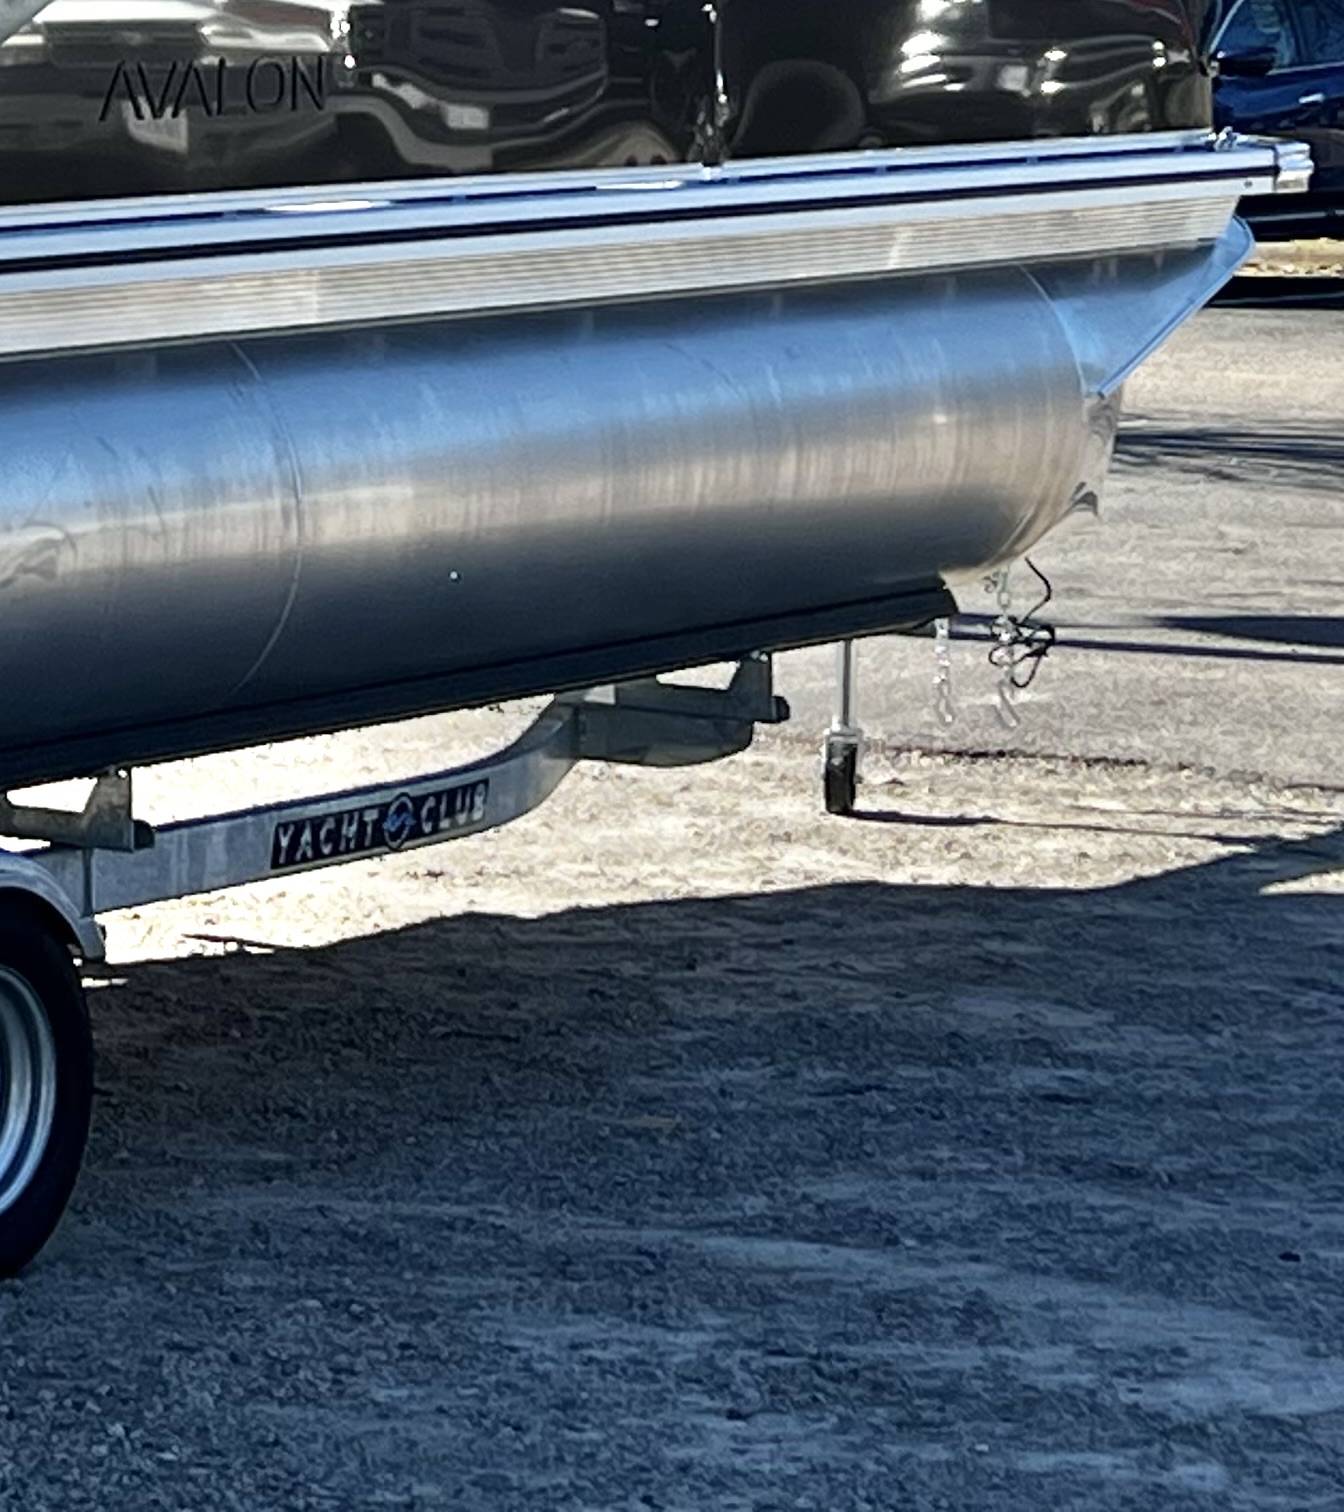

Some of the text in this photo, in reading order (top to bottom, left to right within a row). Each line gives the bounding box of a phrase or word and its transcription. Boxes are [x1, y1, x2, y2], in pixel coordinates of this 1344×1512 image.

[100, 55, 325, 122] AVALON
[278, 783, 487, 864] YACHT CLUB
